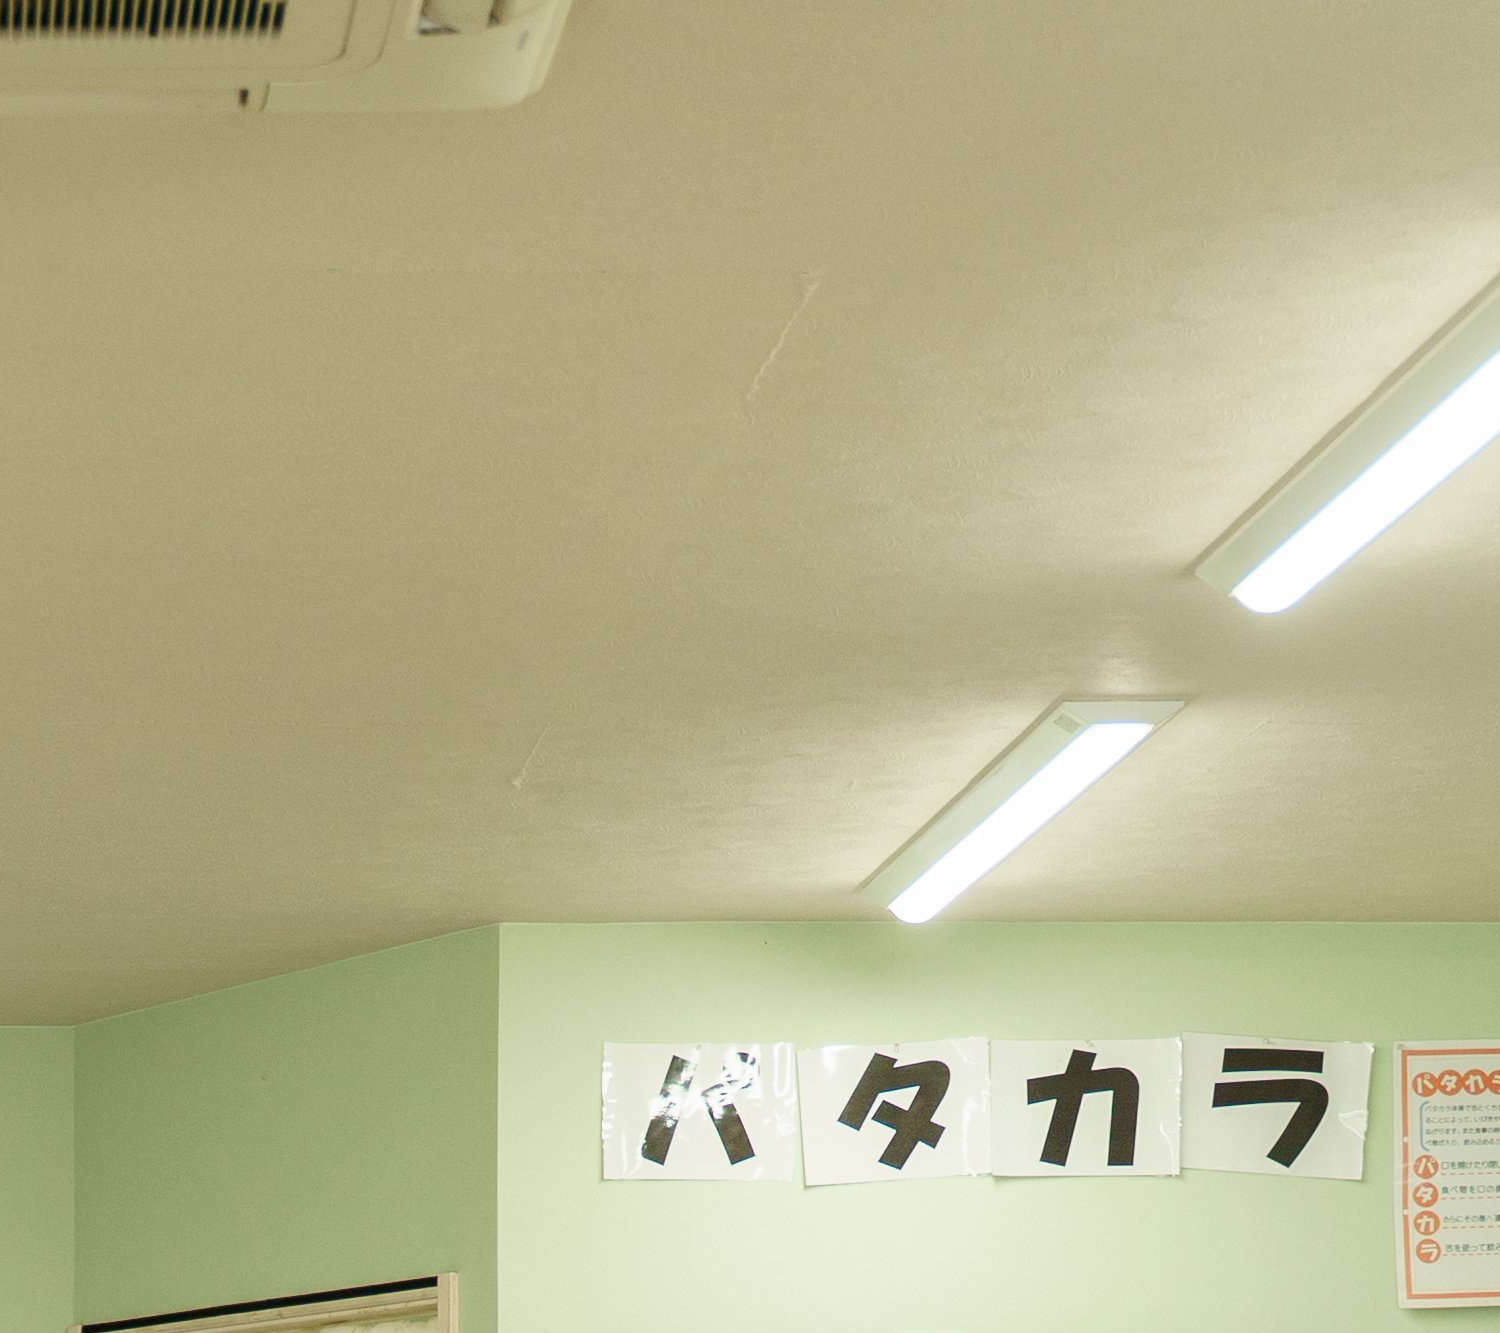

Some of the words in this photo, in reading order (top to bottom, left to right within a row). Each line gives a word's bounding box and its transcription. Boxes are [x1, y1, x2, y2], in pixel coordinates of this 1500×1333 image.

[1417, 1157, 1435, 1175] パ
[1416, 1185, 1434, 1203] タ
[1418, 1214, 1435, 1233] カ
[1421, 1243, 1439, 1262] ラ
